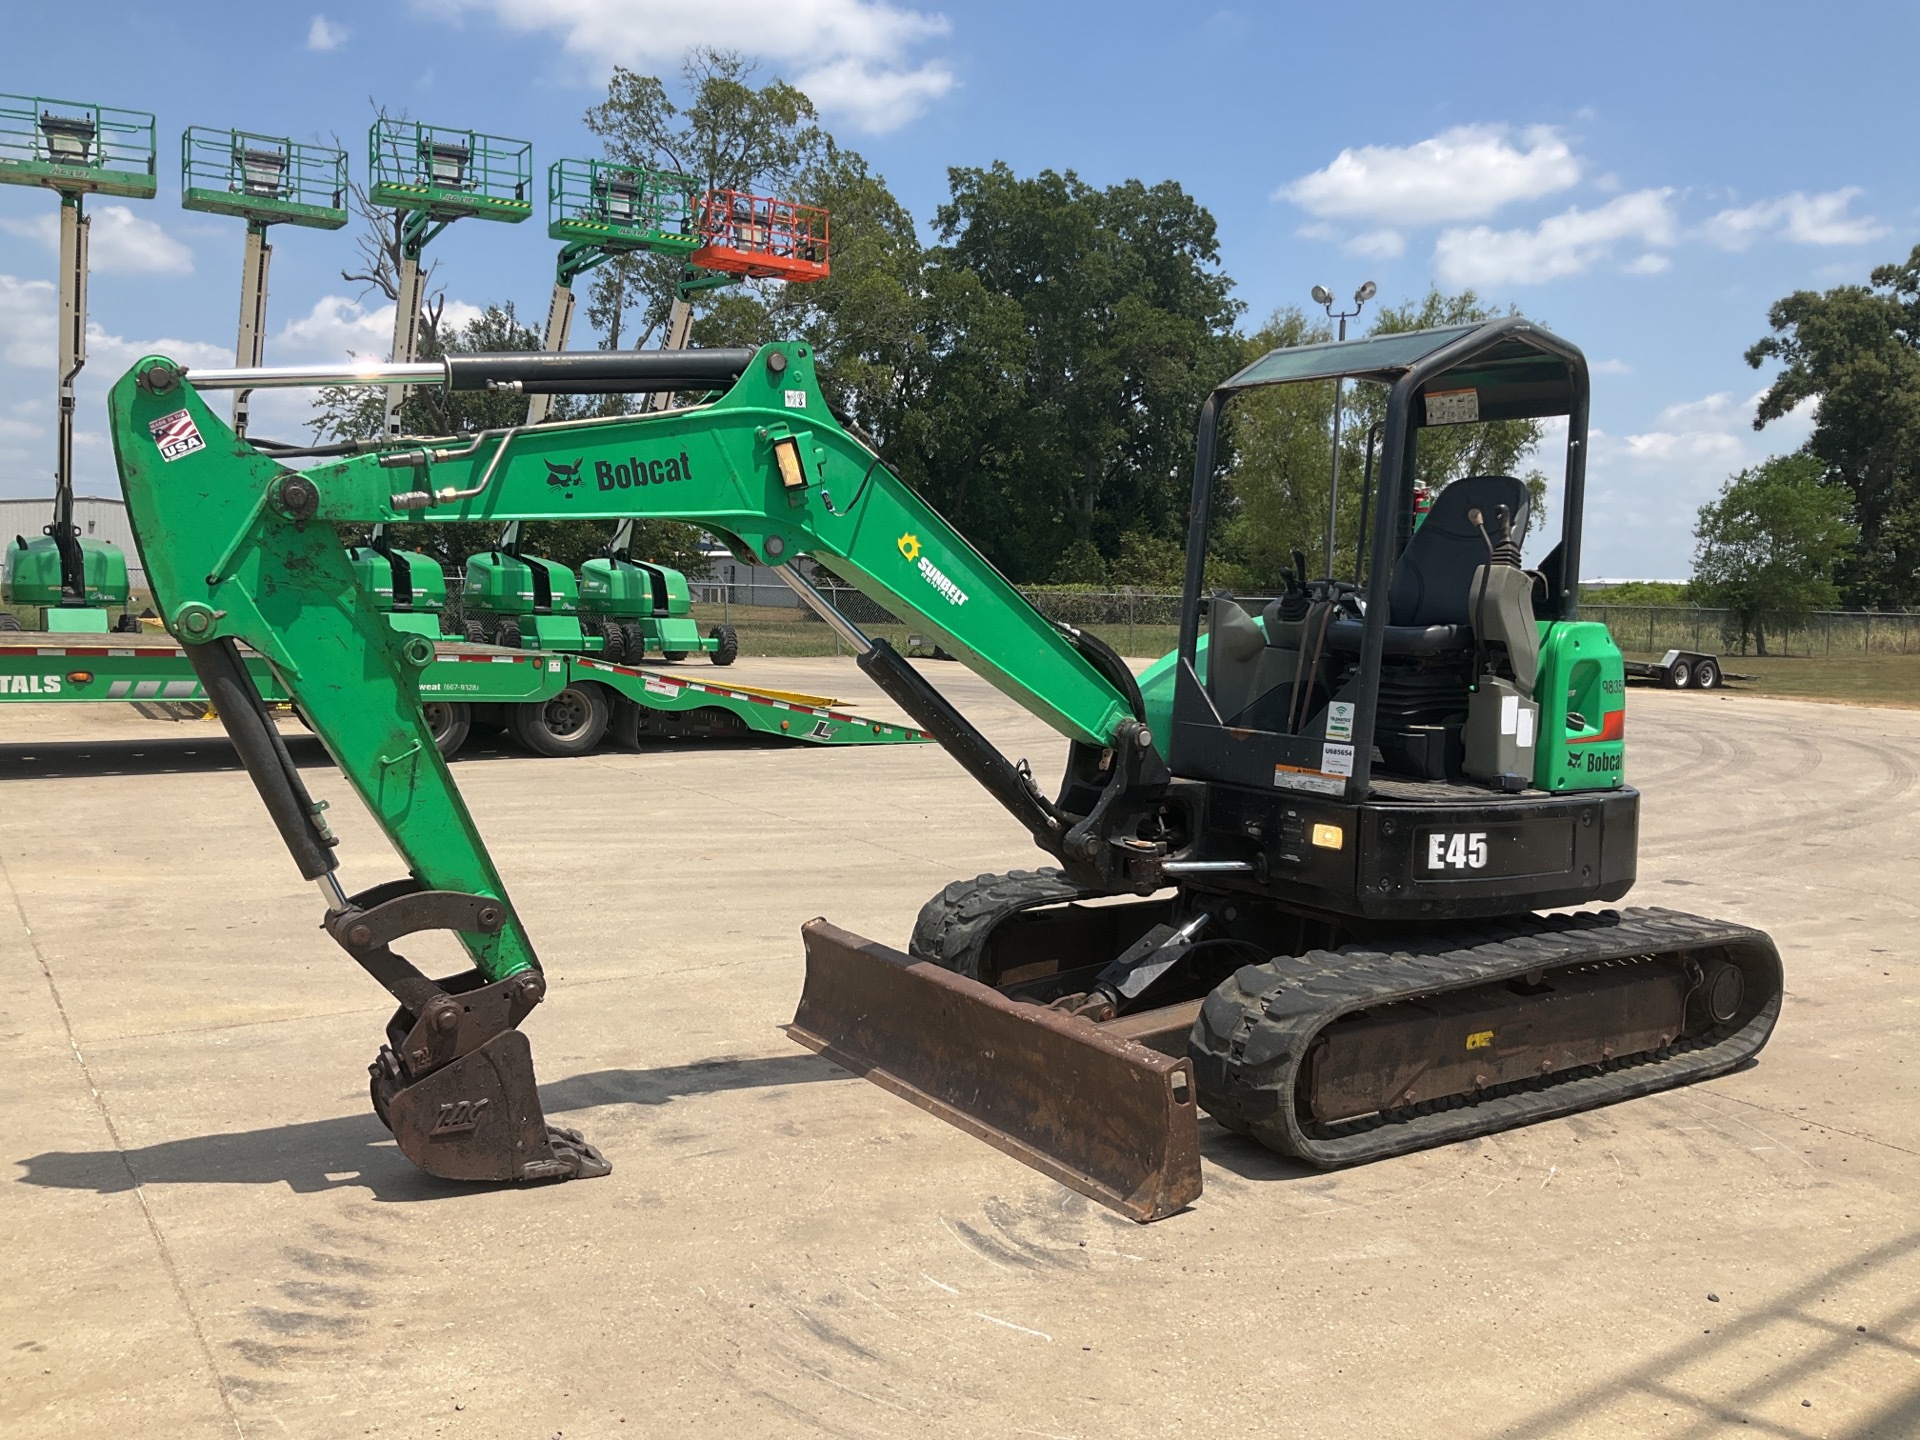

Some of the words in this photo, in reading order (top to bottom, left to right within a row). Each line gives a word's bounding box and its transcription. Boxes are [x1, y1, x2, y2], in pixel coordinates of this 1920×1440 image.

[150, 419, 167, 429] MADE
[163, 436, 201, 457] USA
[594, 451, 692, 491] Bobcat
[917, 556, 969, 606] SUNBELT
[920, 571, 956, 606] RENTALS
[0, 675, 61, 693] TALS
[443, 683, 480, 692] (667-9328)
[1325, 748, 1352, 756] U685654
[1427, 832, 1488, 870] E45
